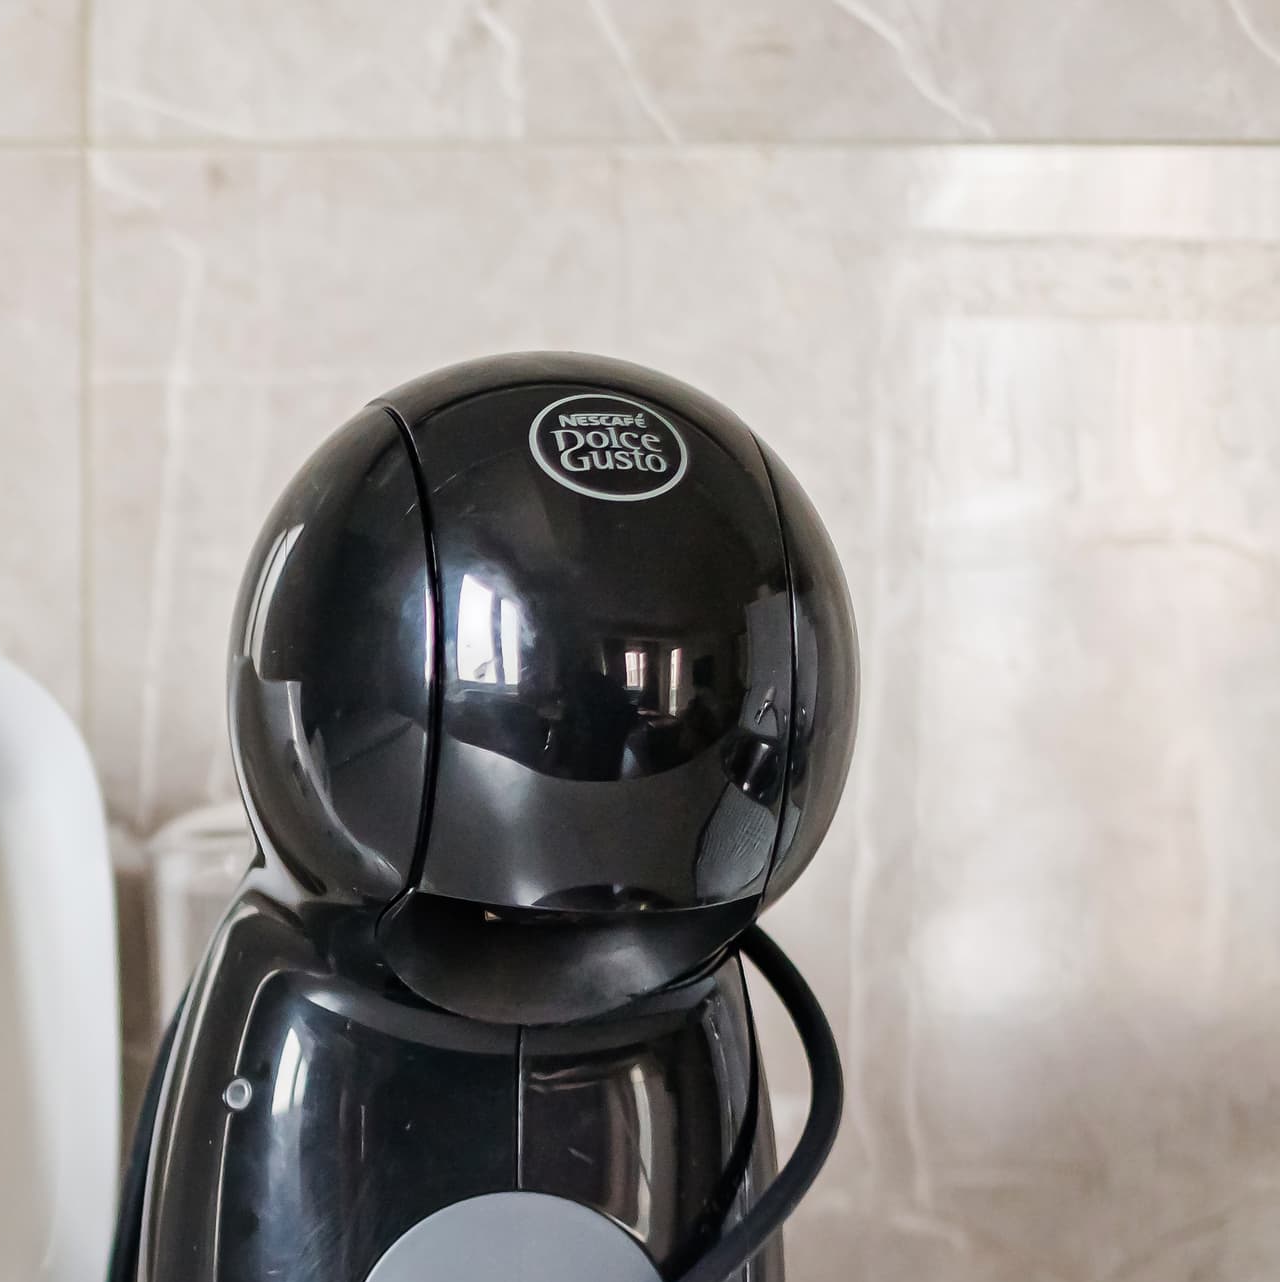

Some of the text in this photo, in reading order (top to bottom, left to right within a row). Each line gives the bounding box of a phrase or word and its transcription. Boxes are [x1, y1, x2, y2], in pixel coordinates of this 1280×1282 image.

[558, 413, 648, 429] NESCAFÉ
[549, 427, 662, 452] Dolce
[560, 449, 667, 473] Gusto
